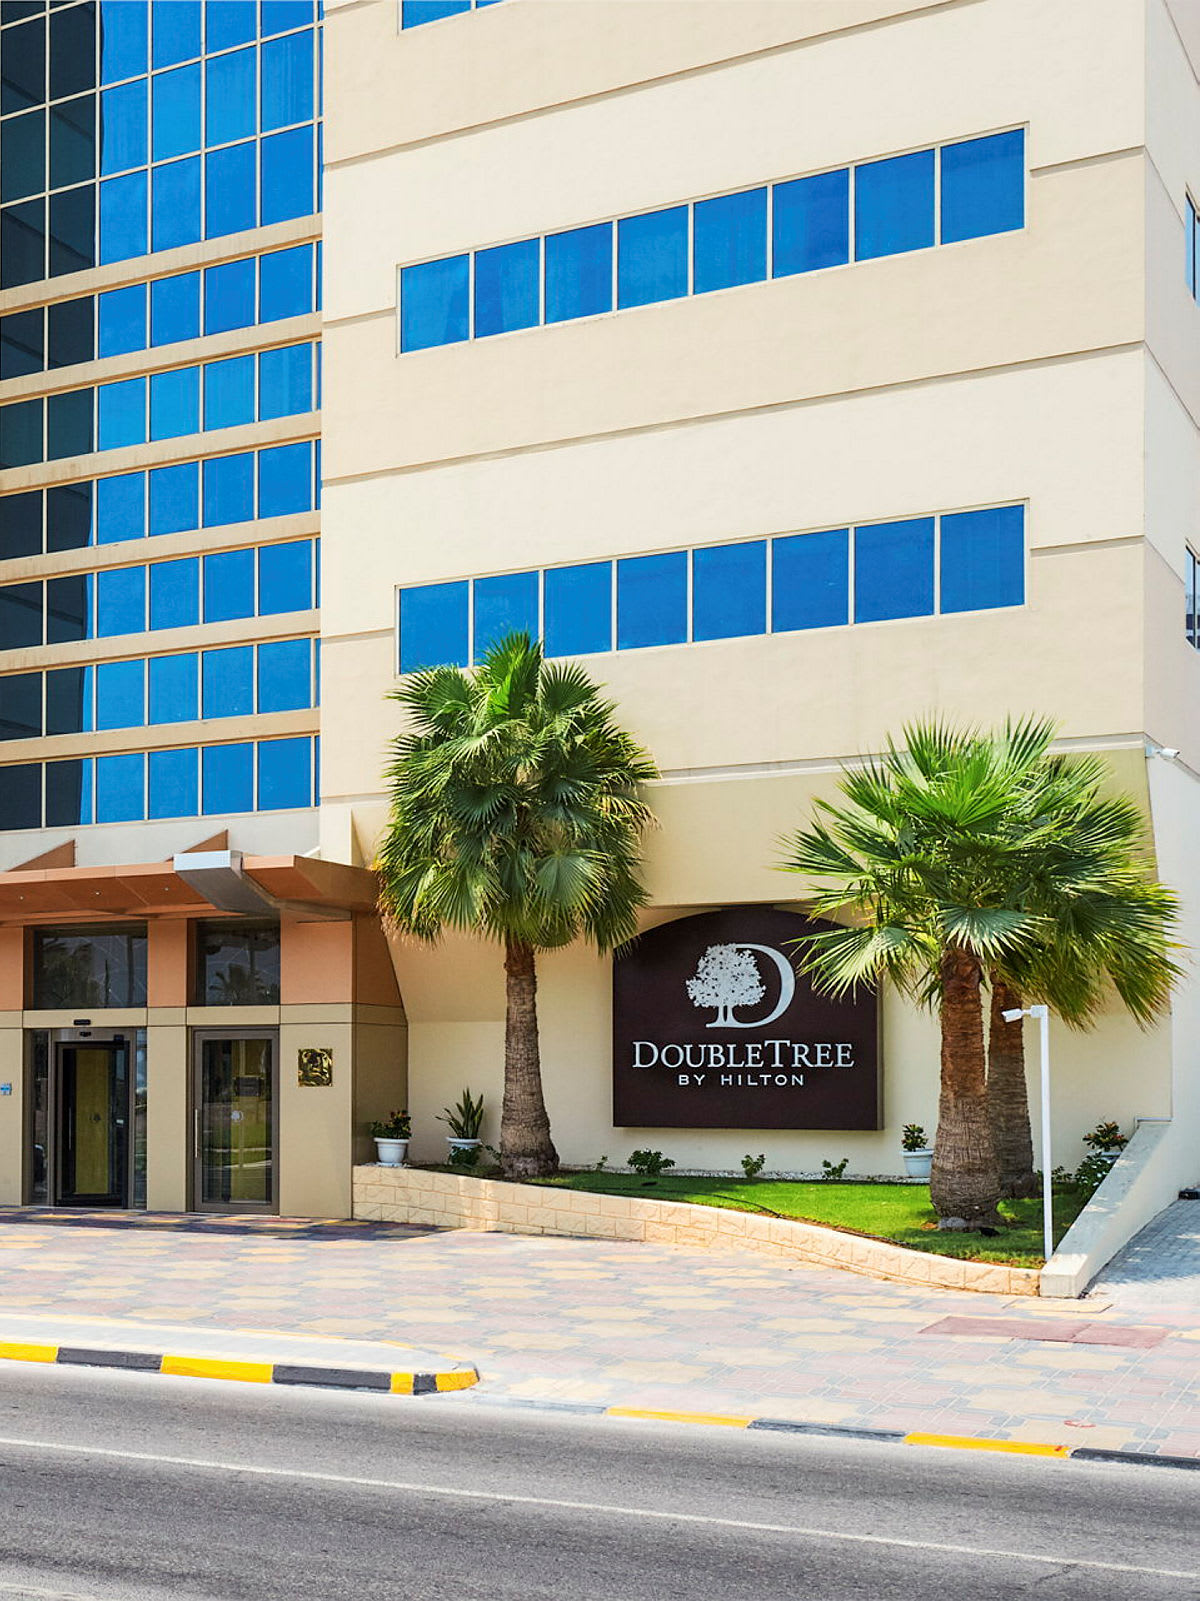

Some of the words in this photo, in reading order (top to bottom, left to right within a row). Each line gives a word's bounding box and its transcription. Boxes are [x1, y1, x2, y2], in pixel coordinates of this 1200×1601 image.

[632, 1039, 855, 1068] DOUBLETREE
[678, 1074, 706, 1086] BY
[721, 1074, 805, 1086] HILTON
